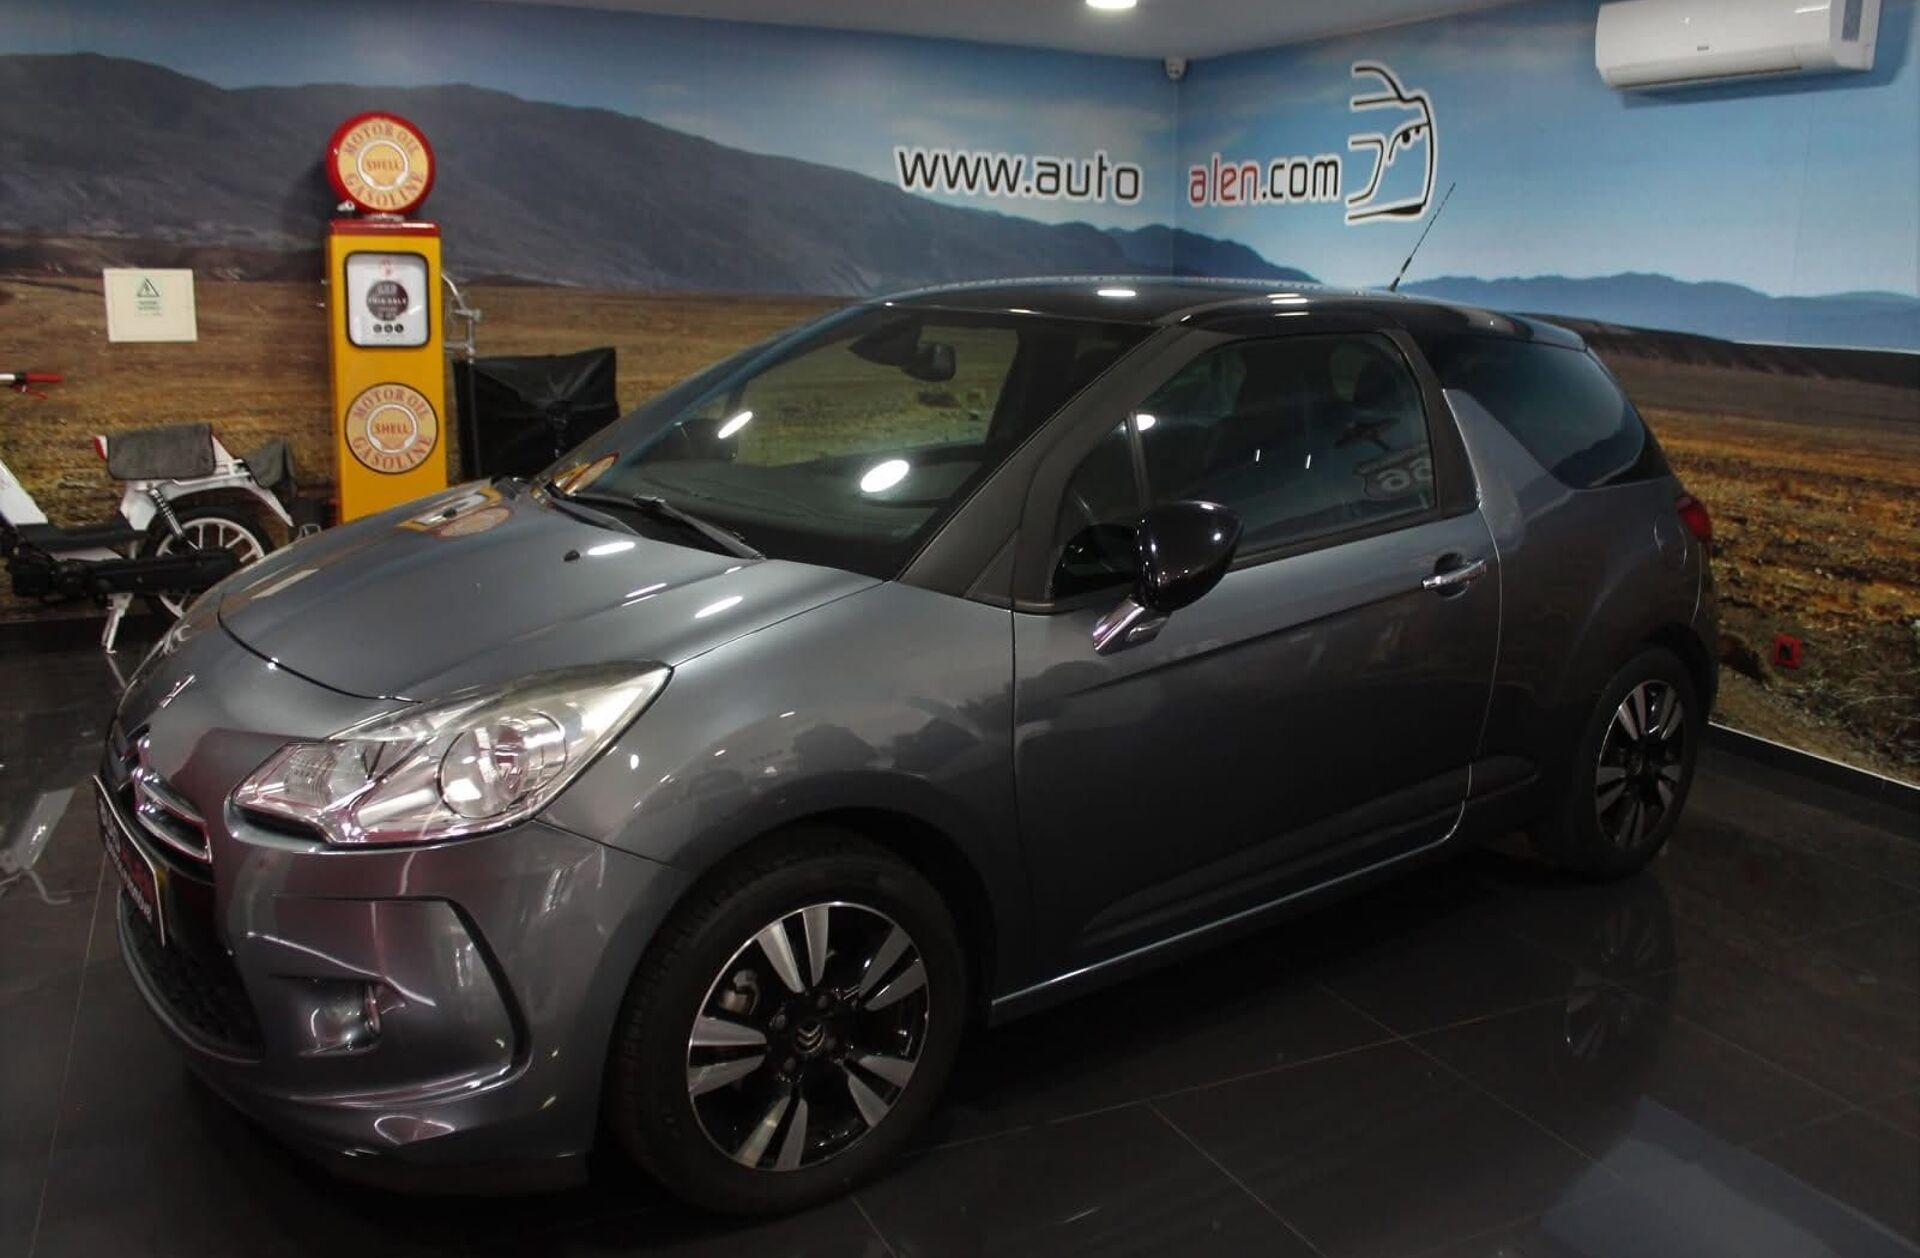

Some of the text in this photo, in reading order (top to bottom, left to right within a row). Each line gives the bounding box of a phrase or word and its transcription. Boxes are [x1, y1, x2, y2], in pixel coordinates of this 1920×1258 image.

[345, 123, 420, 156] MOTOR OIL
[366, 159, 399, 171] SHELL
[899, 150, 1339, 203] www.auto alen.com
[345, 173, 423, 207] GASOLINE
[353, 388, 430, 419] MOTOR OIL
[375, 423, 409, 433] SHELL
[353, 435, 433, 469] GASOLINE
